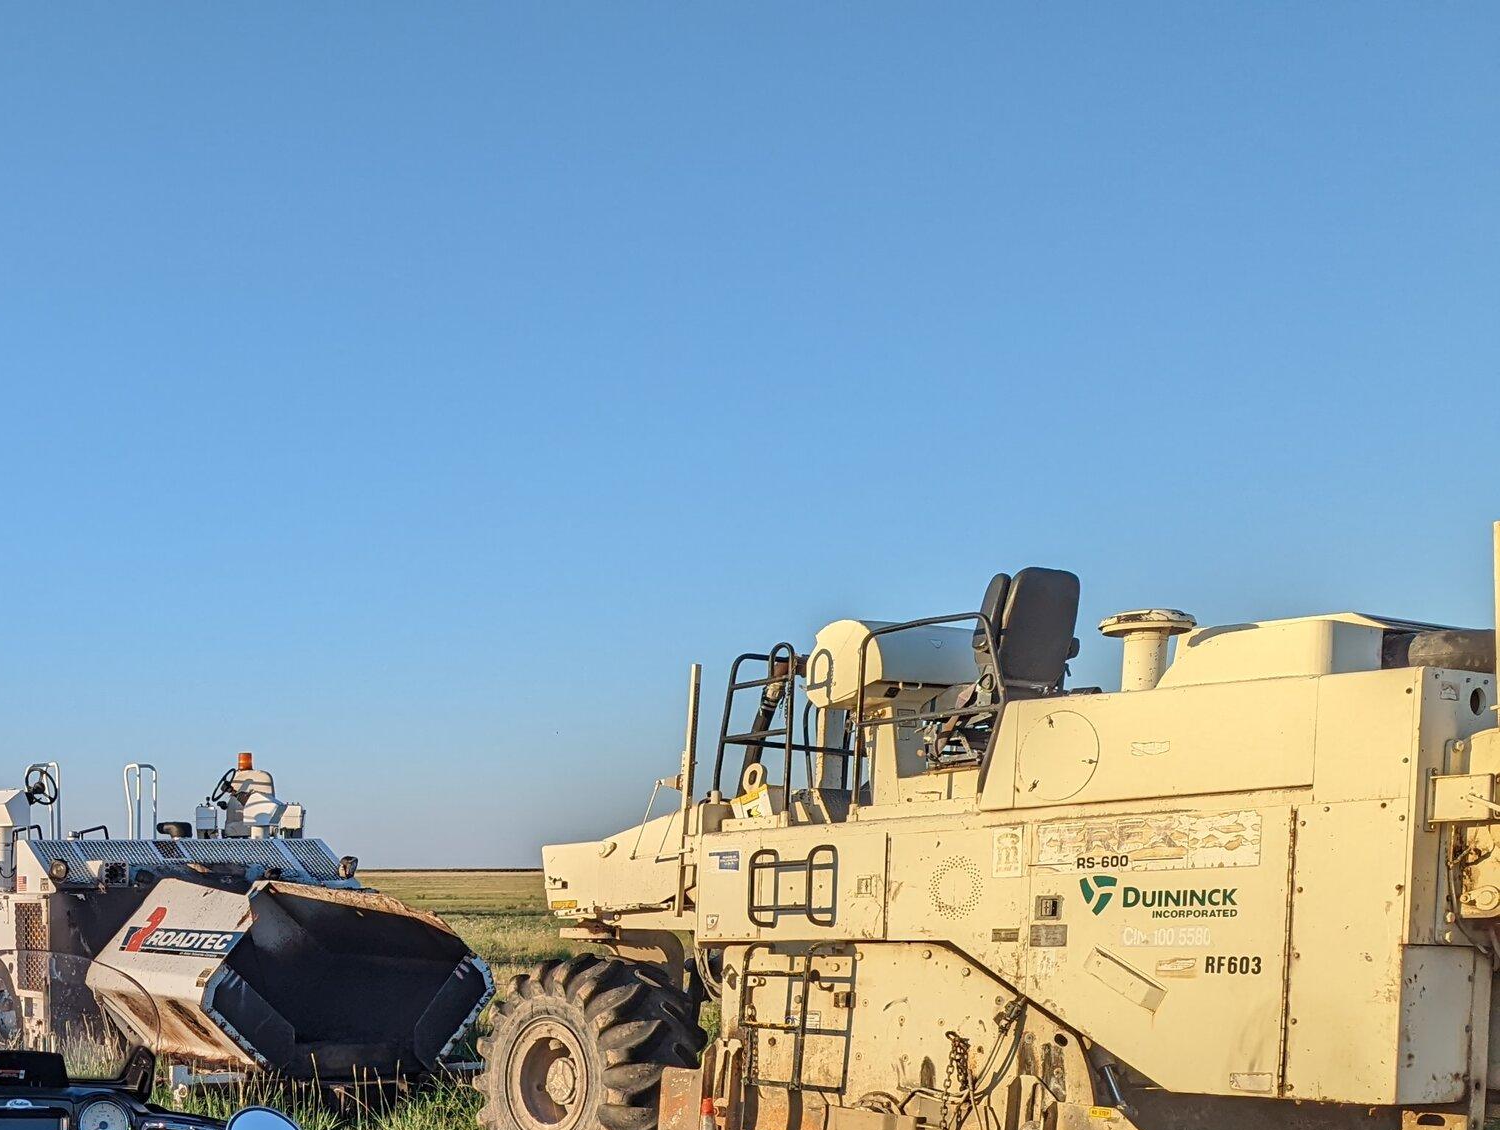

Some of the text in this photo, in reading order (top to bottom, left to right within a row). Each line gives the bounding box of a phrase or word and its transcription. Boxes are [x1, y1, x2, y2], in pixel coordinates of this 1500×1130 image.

[1076, 855, 1129, 869] RS-600
[1122, 887, 1238, 908] DUININCK
[1151, 908, 1238, 918] INCORPORATED
[146, 931, 233, 950] ROADTEC
[1178, 927, 1211, 946] 5580
[1204, 956, 1262, 975] RF603
